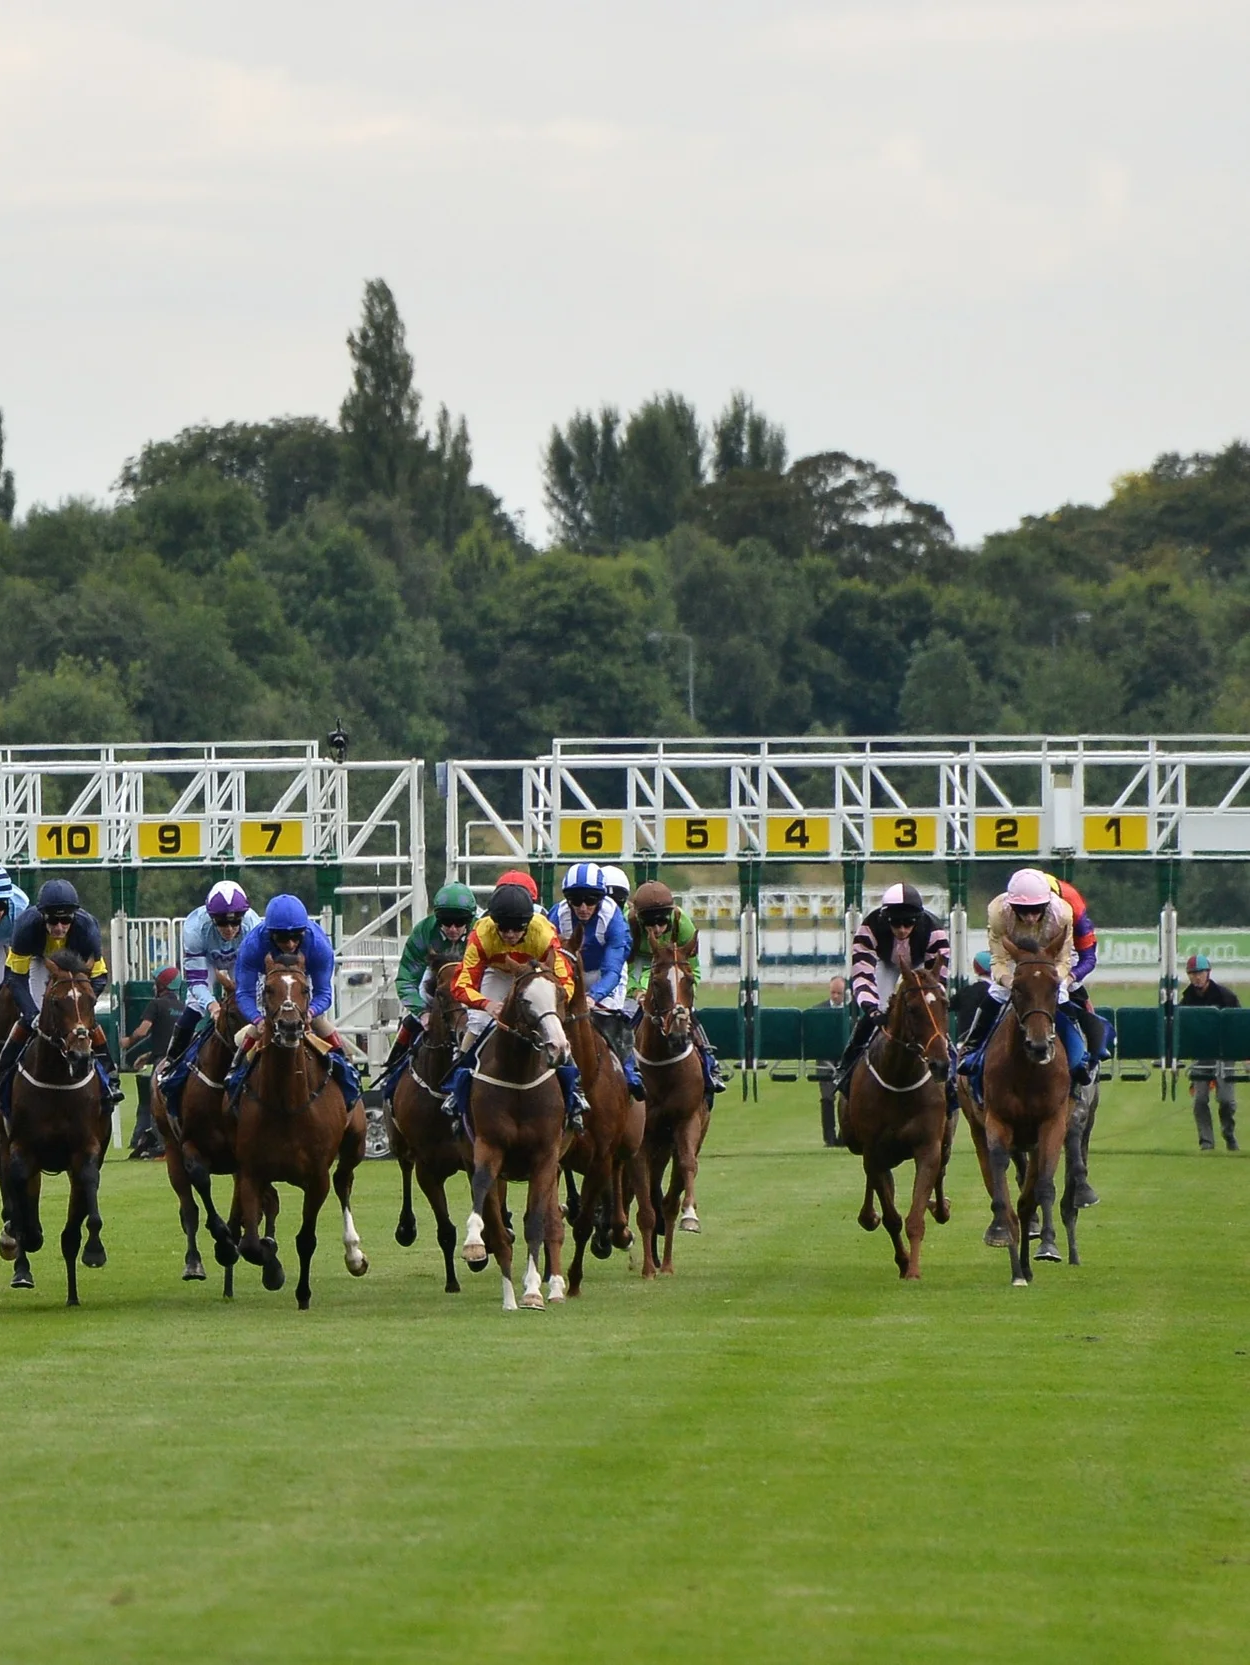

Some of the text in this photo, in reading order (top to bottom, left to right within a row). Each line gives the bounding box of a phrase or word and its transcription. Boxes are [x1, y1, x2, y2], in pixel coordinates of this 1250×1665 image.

[46, 825, 91, 856] 10
[158, 824, 181, 855] 9
[260, 822, 283, 853] 7
[580, 820, 604, 850] 6
[685, 819, 709, 850] 5
[784, 818, 810, 849] 4
[894, 818, 918, 848] 3
[994, 817, 1019, 848] 2
[1104, 817, 1121, 847] 1
